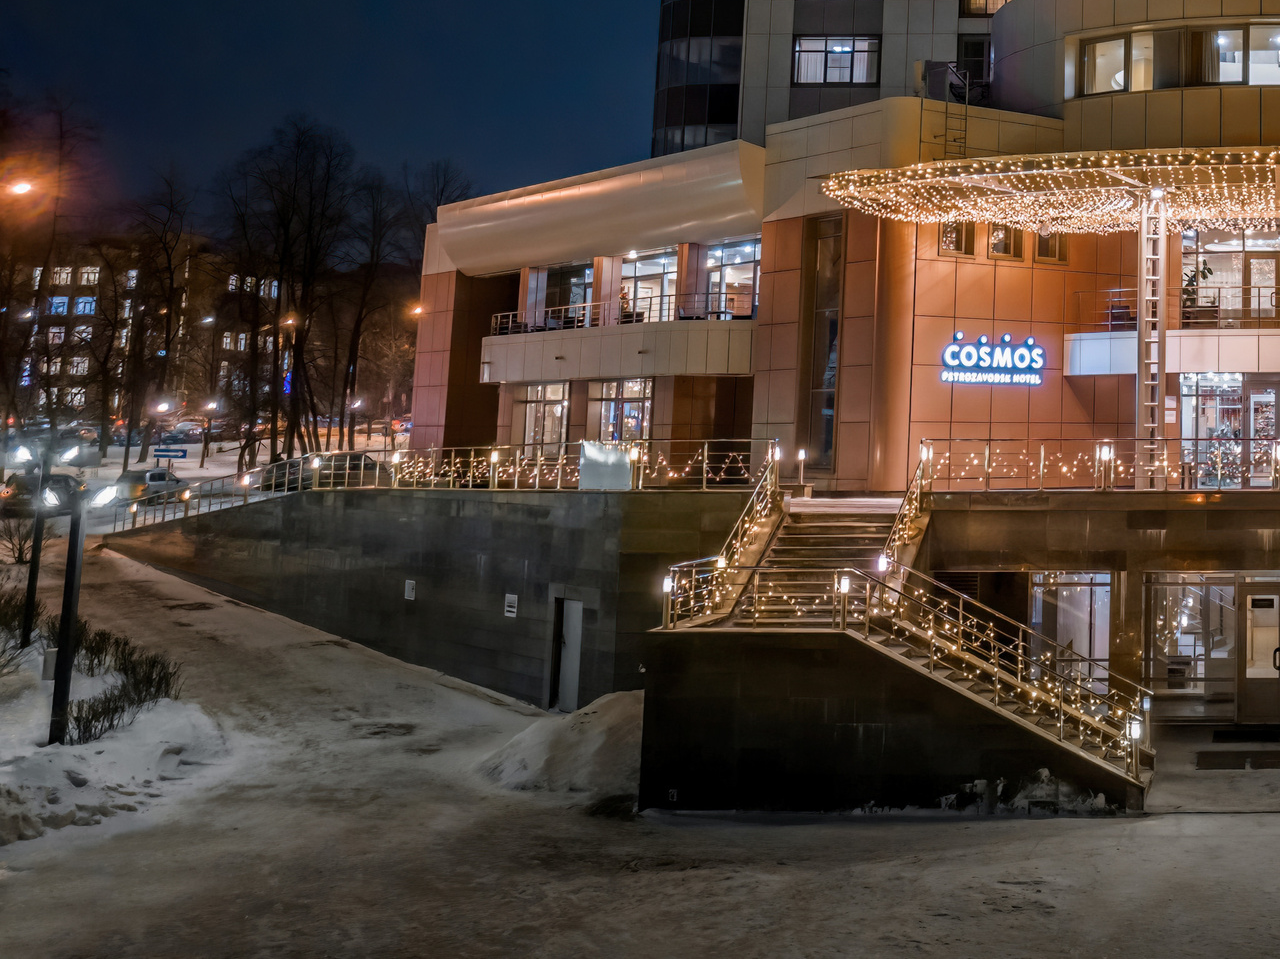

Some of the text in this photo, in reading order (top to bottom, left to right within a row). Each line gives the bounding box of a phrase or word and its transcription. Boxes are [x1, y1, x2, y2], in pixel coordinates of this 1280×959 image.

[943, 344, 1045, 369] COSMOS
[941, 371, 1042, 385] PETROZAVODSK HOTEL
